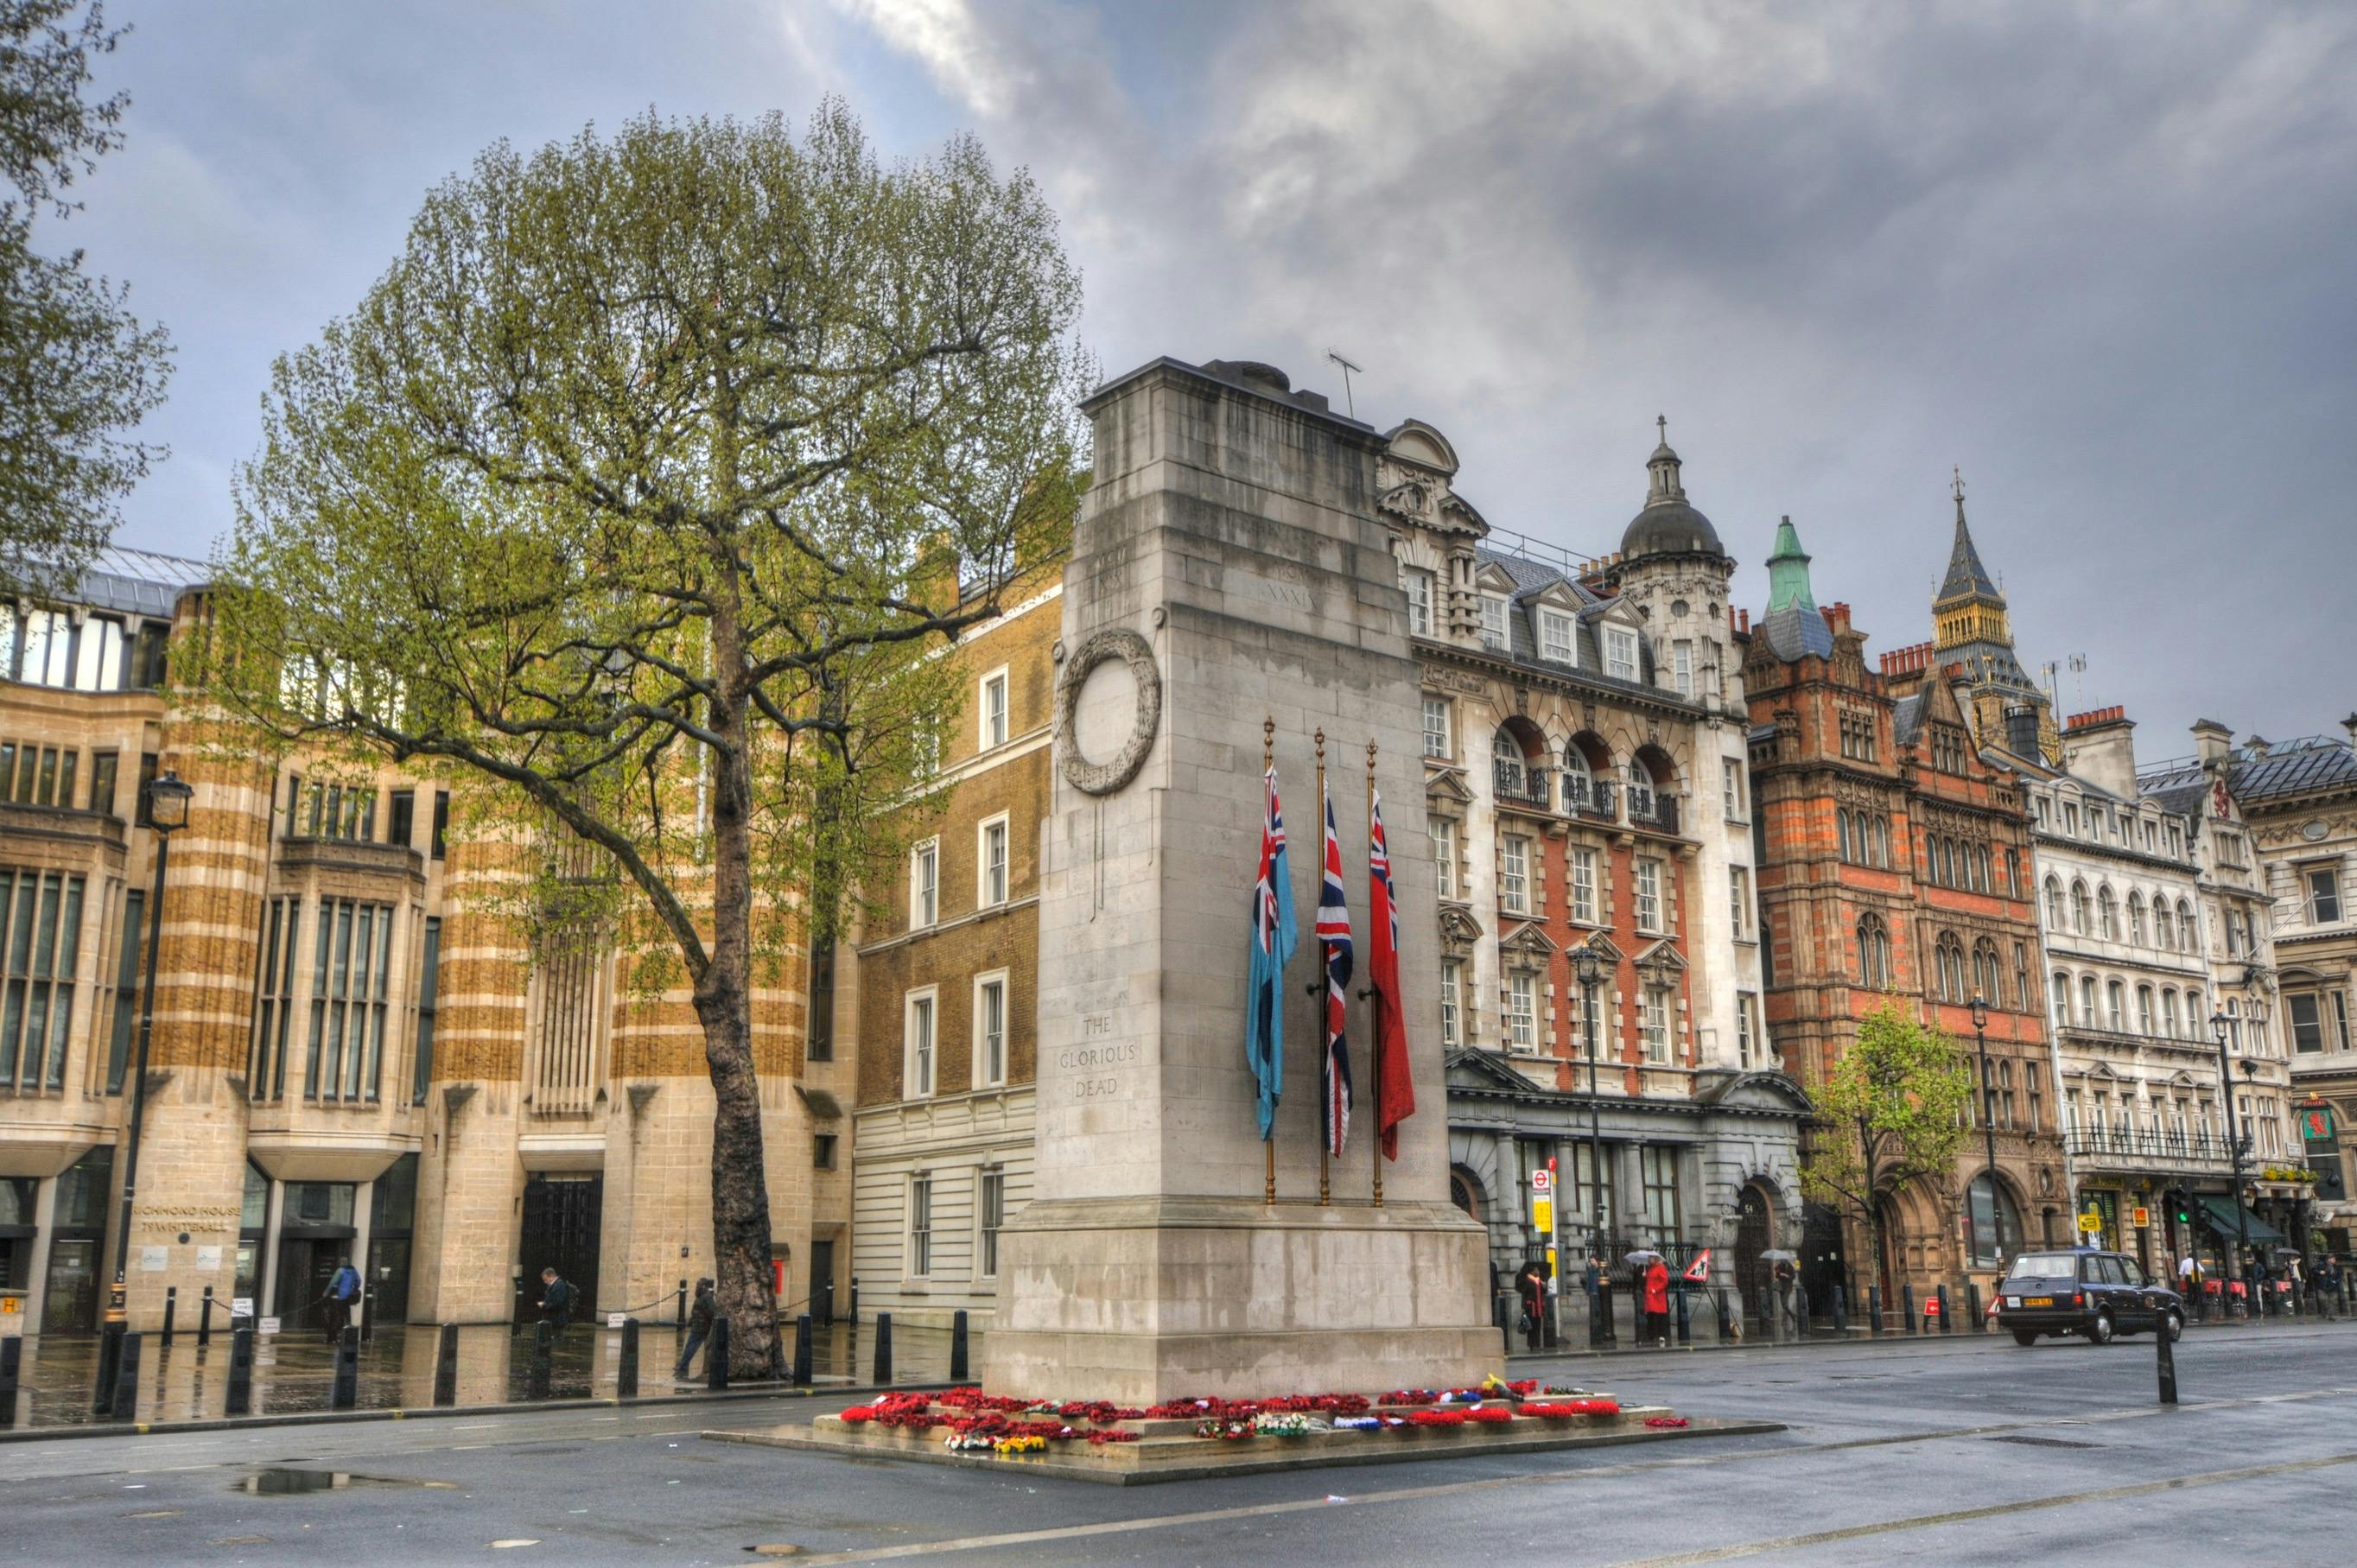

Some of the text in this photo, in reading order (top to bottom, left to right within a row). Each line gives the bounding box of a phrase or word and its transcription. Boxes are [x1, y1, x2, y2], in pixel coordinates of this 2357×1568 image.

[1083, 1016, 1111, 1036] THE
[1060, 1044, 1135, 1069] GLORIOUS
[1076, 1077, 1118, 1098] DEAD
[130, 1205, 242, 1217] RICHMOND HOUSE
[155, 1221, 227, 1233] WHITEHALL
